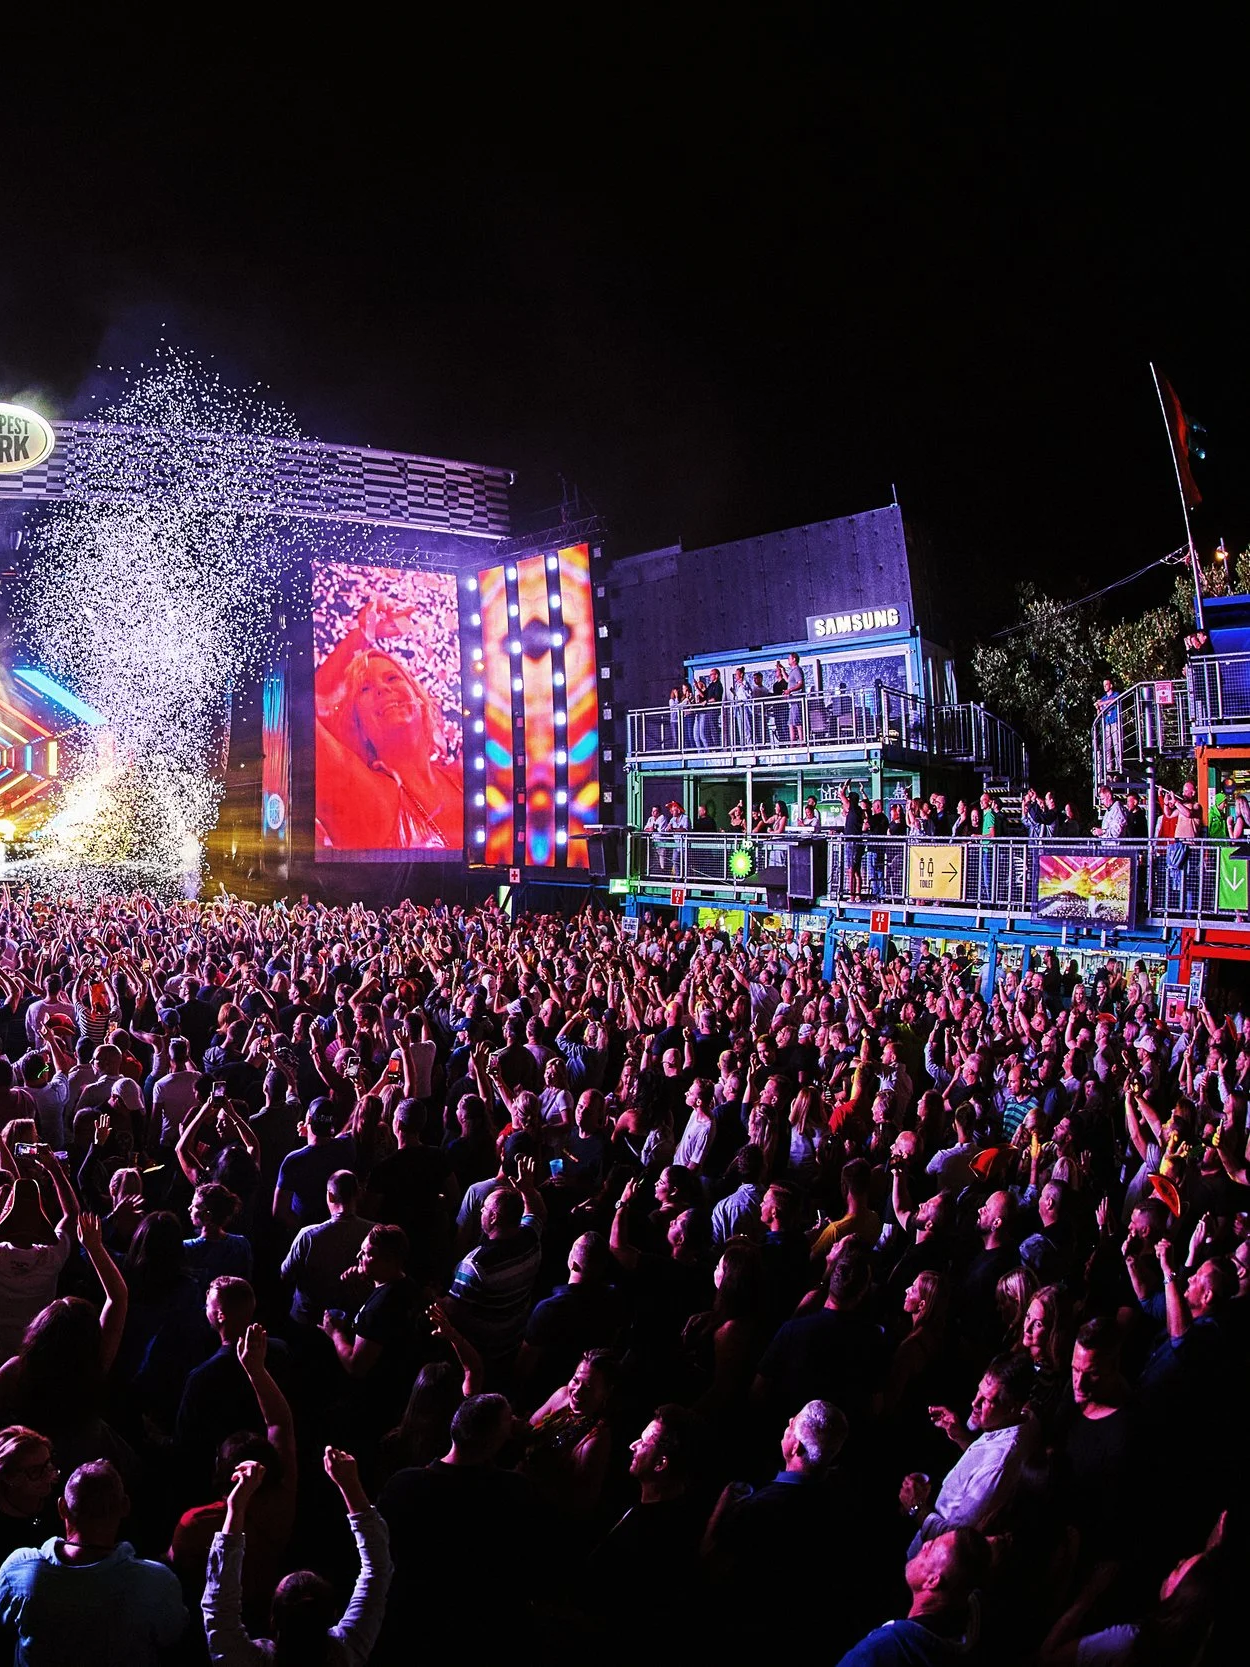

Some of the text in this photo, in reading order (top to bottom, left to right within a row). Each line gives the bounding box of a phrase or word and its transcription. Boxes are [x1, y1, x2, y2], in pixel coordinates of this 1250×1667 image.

[814, 608, 899, 637] SAMSUNG
[919, 880, 934, 889] TOILET
[875, 913, 885, 923] J2
